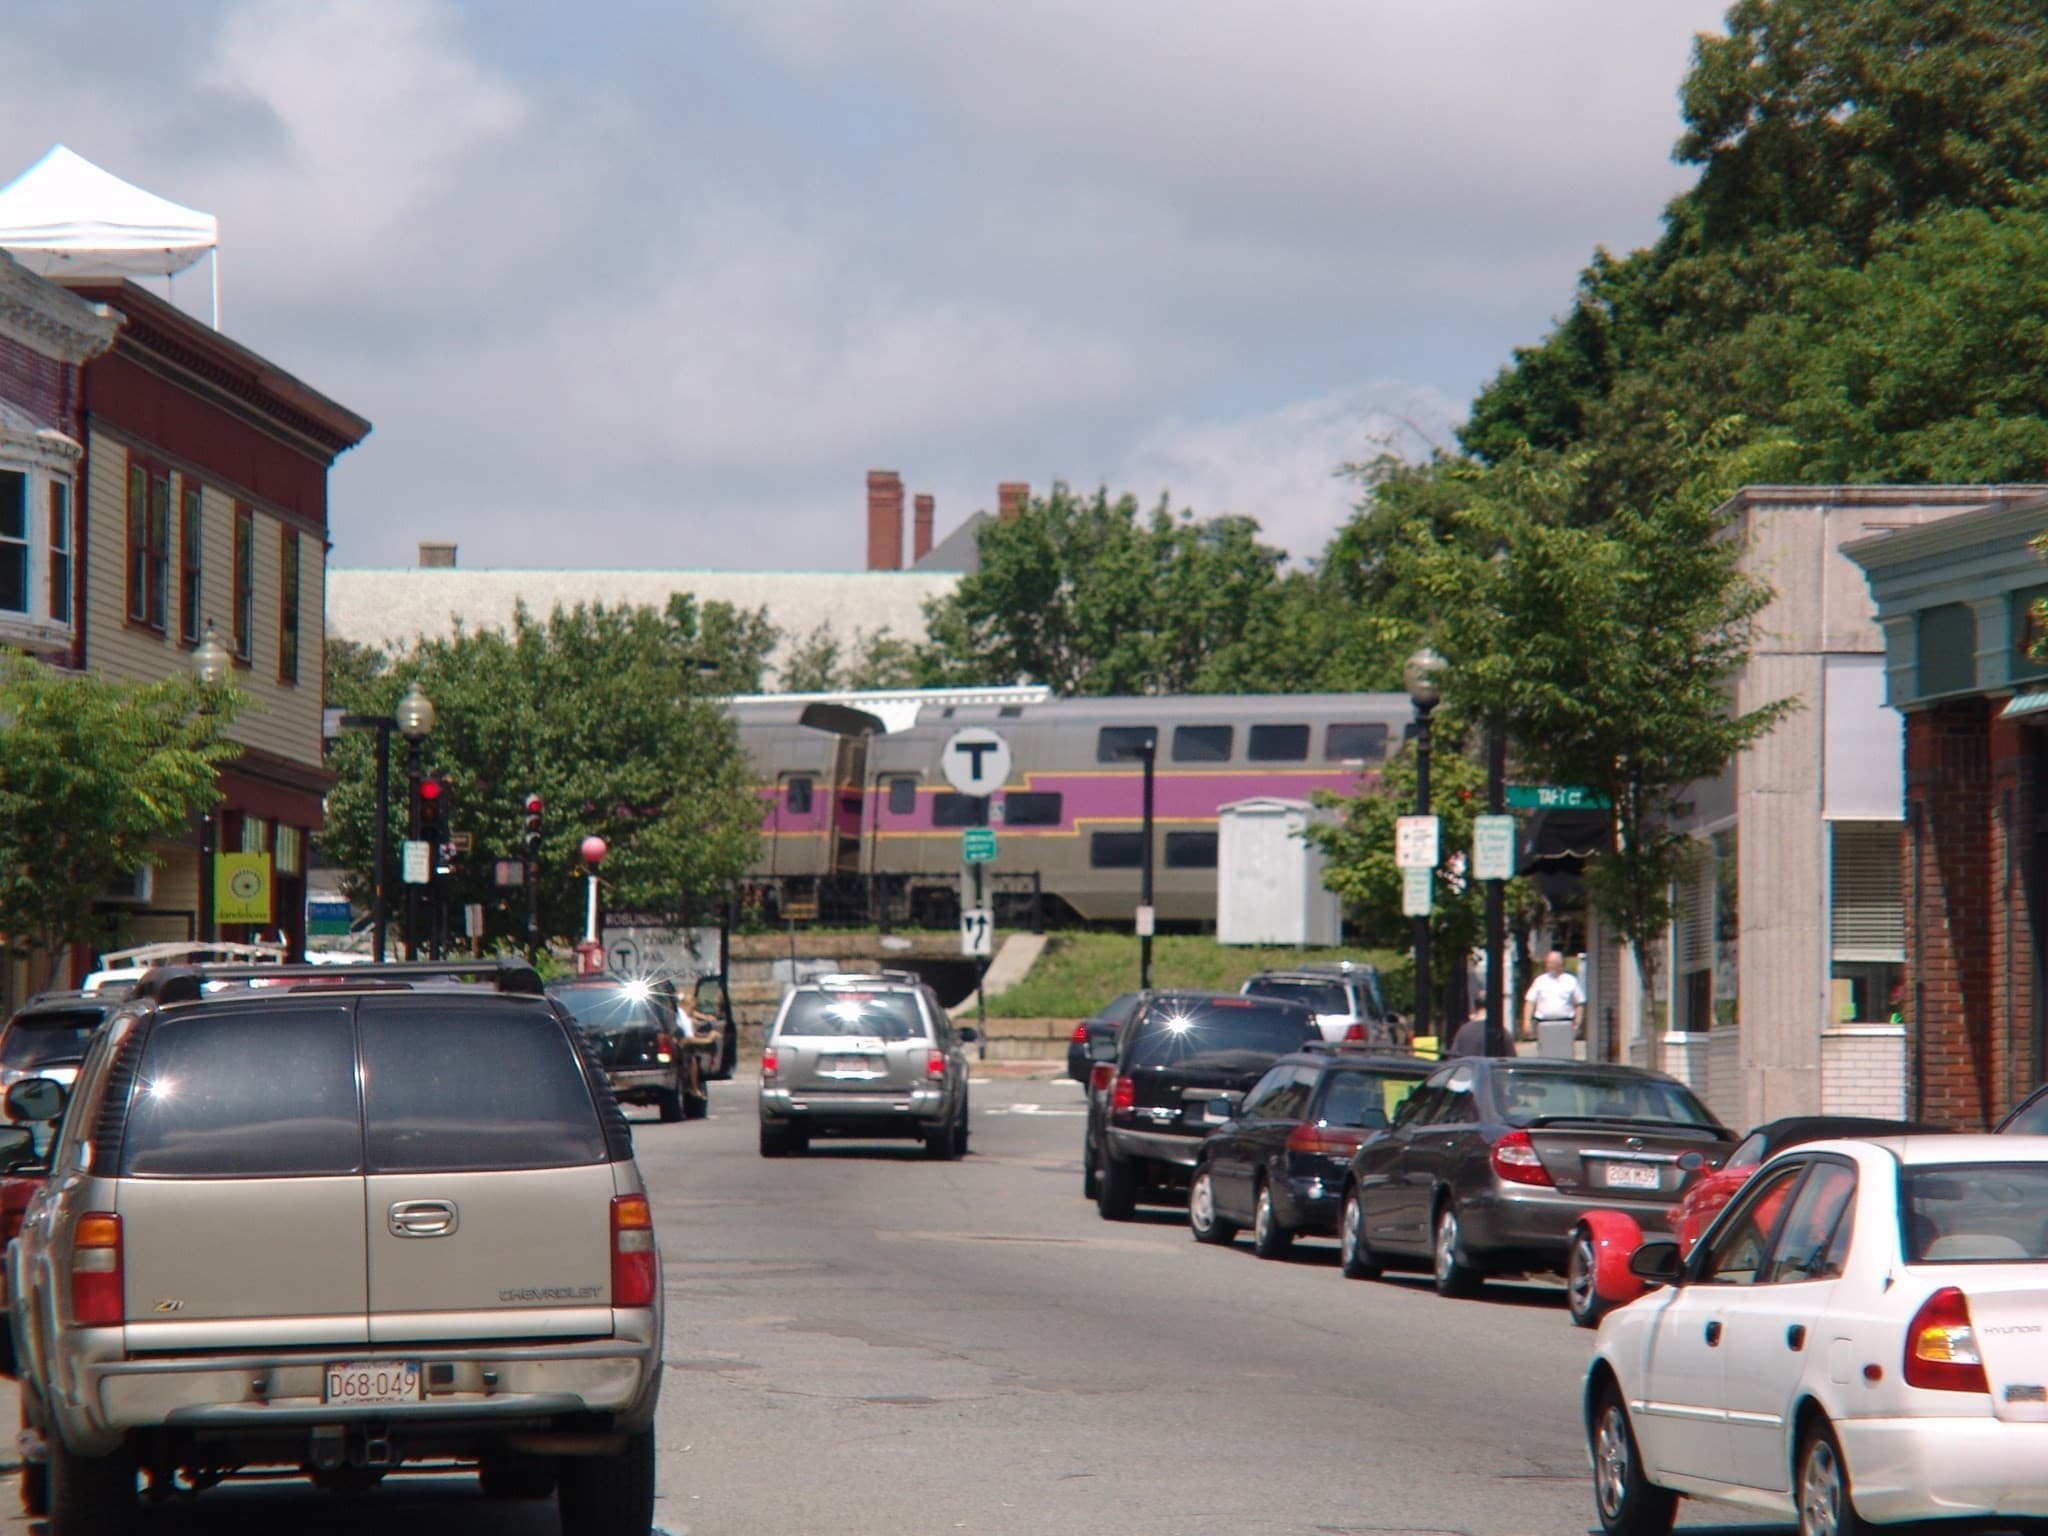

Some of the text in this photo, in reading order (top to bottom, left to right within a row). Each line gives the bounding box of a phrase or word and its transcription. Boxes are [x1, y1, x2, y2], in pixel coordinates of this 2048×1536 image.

[955, 743, 997, 780] T
[615, 949, 631, 968] T
[498, 1286, 605, 1302] CHEVROLET
